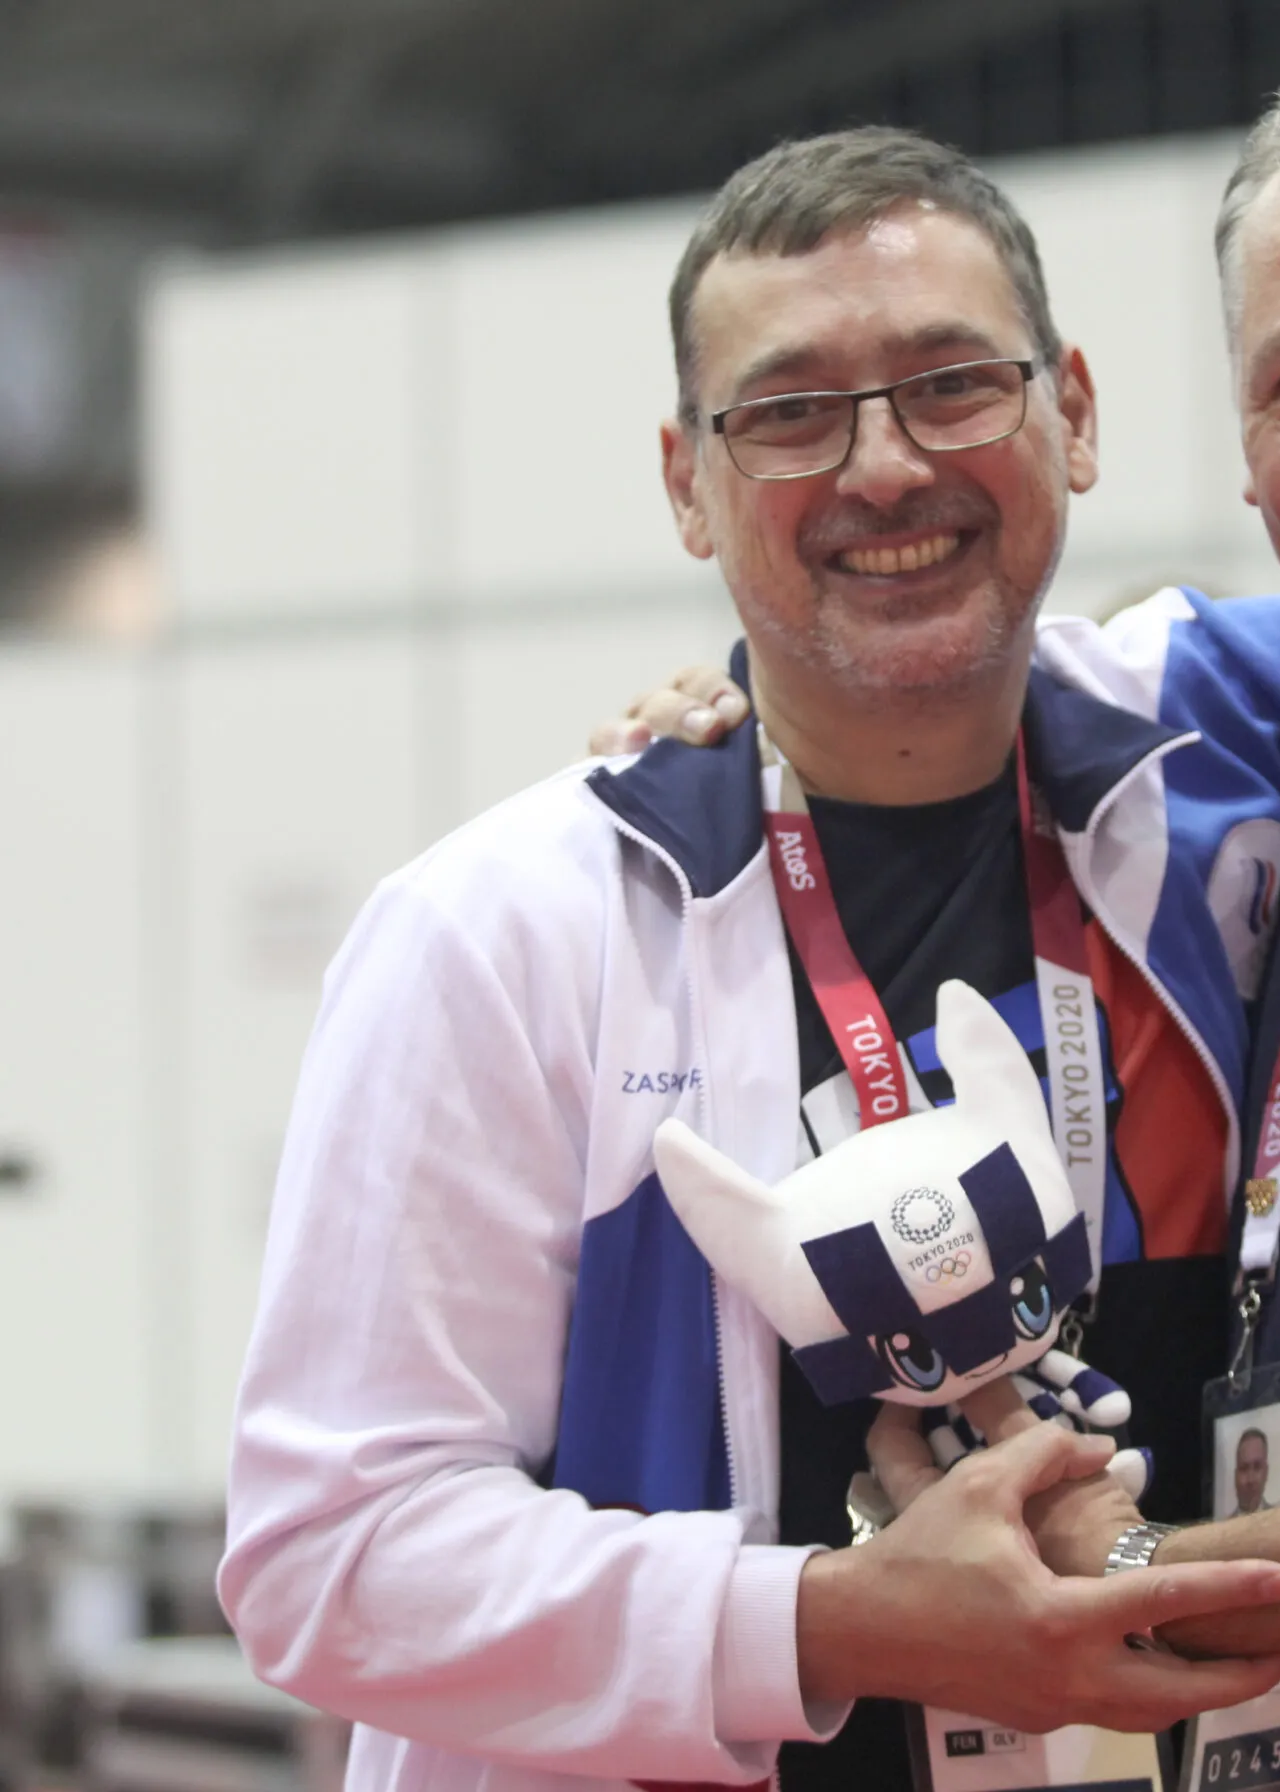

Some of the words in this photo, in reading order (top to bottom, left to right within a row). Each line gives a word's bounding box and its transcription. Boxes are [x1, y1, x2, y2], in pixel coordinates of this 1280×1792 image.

[775, 830, 816, 891] Atos
[1053, 984, 1087, 1056] 2020
[846, 1013, 899, 1116] TOKYO
[1062, 1064, 1093, 1168] TOKYO
[907, 1244, 945, 1271] TOKYO
[946, 1232, 974, 1251] 2020
